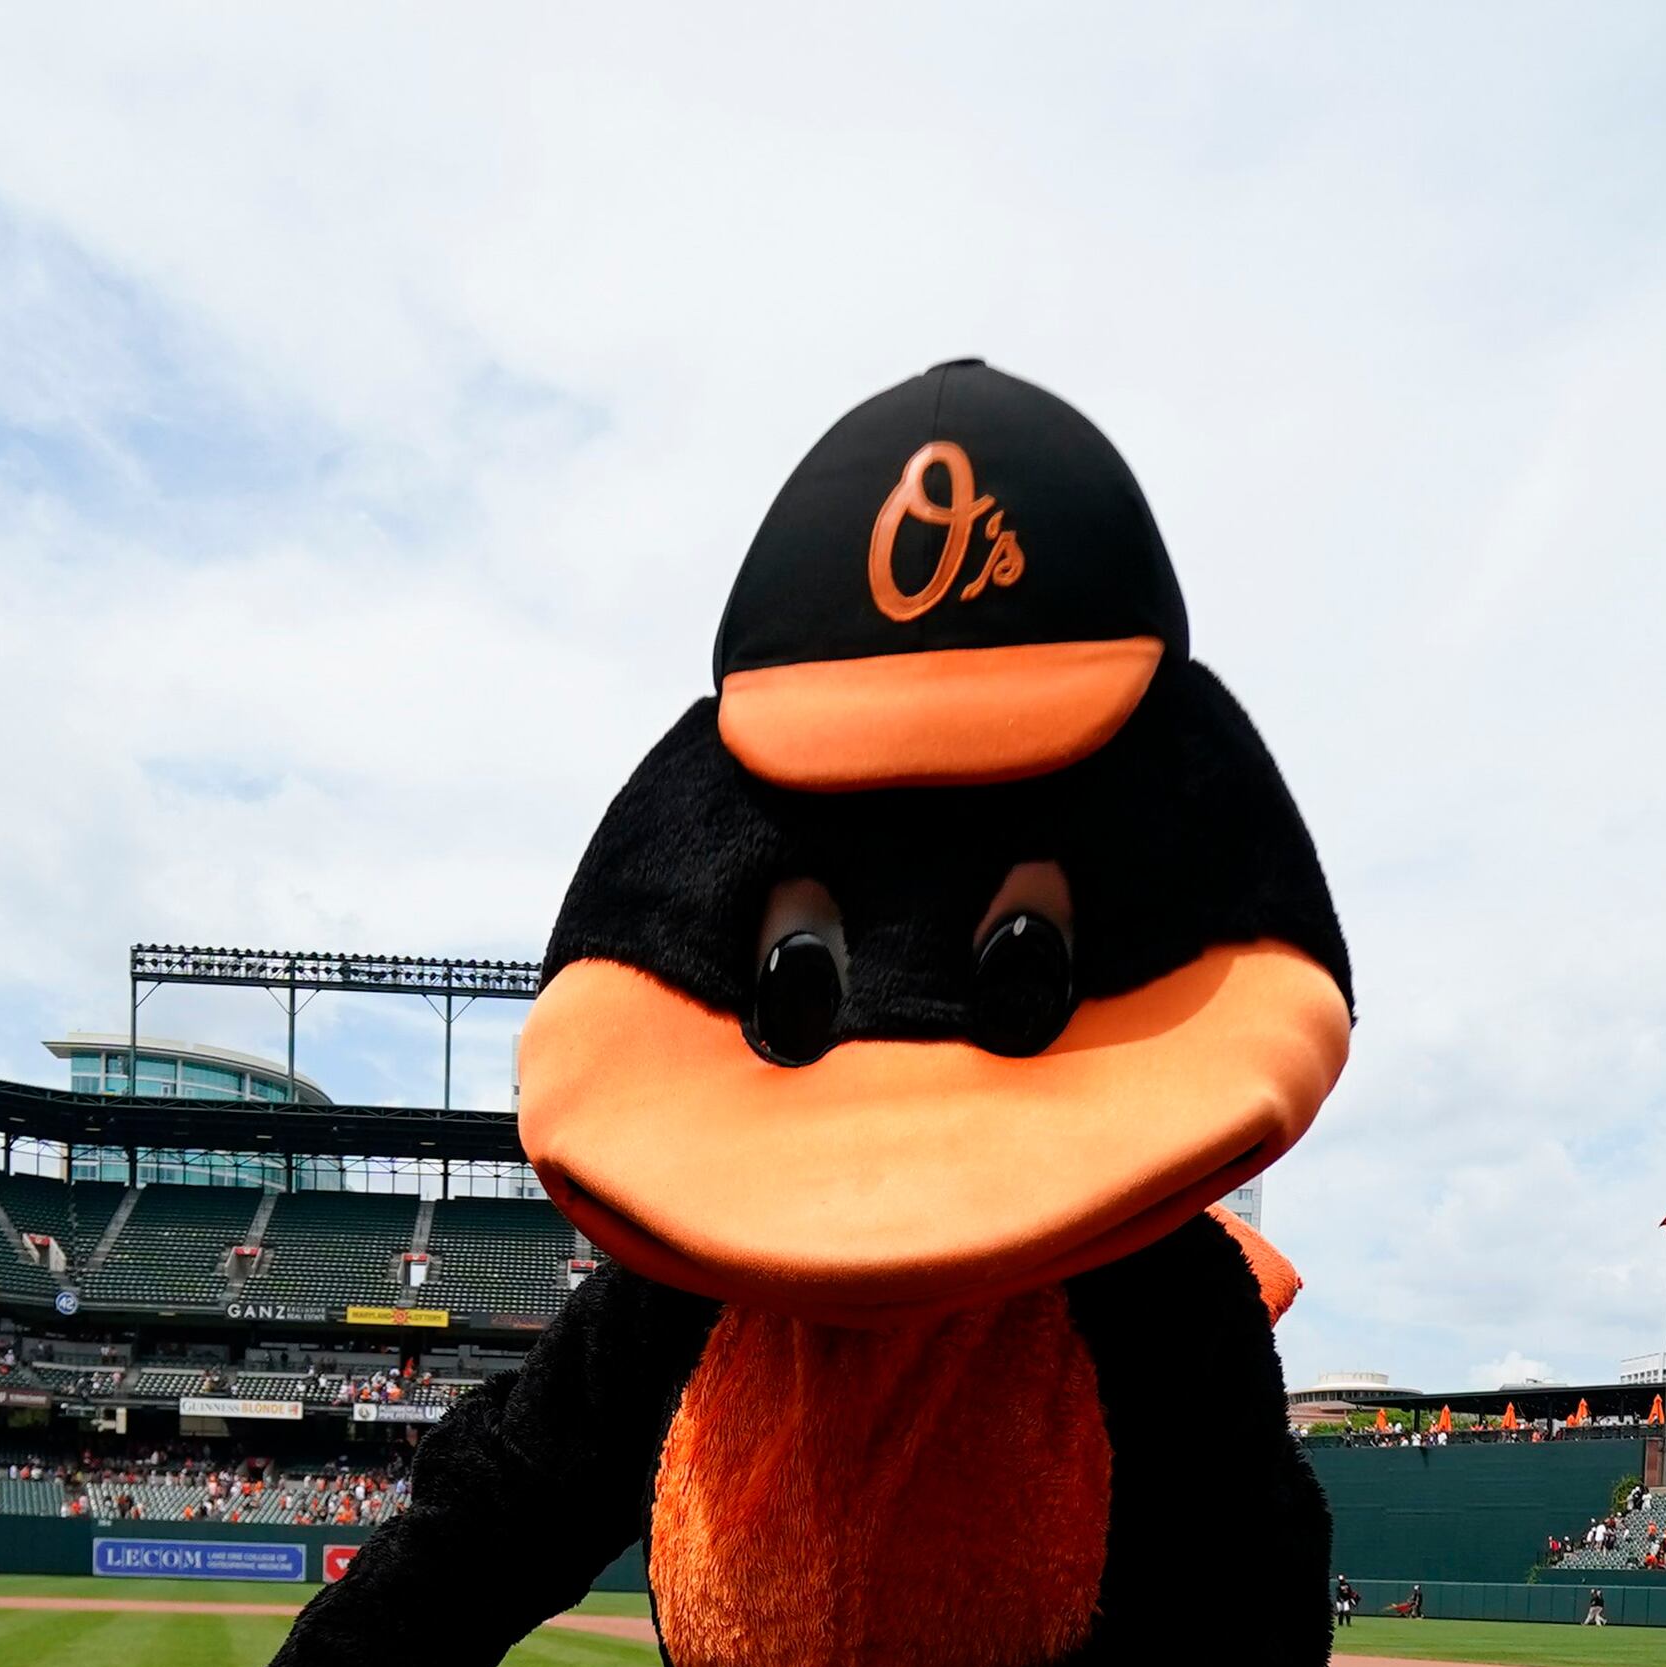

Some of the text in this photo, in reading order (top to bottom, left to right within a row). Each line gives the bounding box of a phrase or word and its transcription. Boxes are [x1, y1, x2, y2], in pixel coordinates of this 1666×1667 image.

[867, 440, 1026, 622] O's
[58, 1297, 75, 1309] 42
[227, 1303, 286, 1320] GANZ
[181, 1400, 285, 1415] GUINNESS BLONDE
[106, 1547, 202, 1569] LECOM
